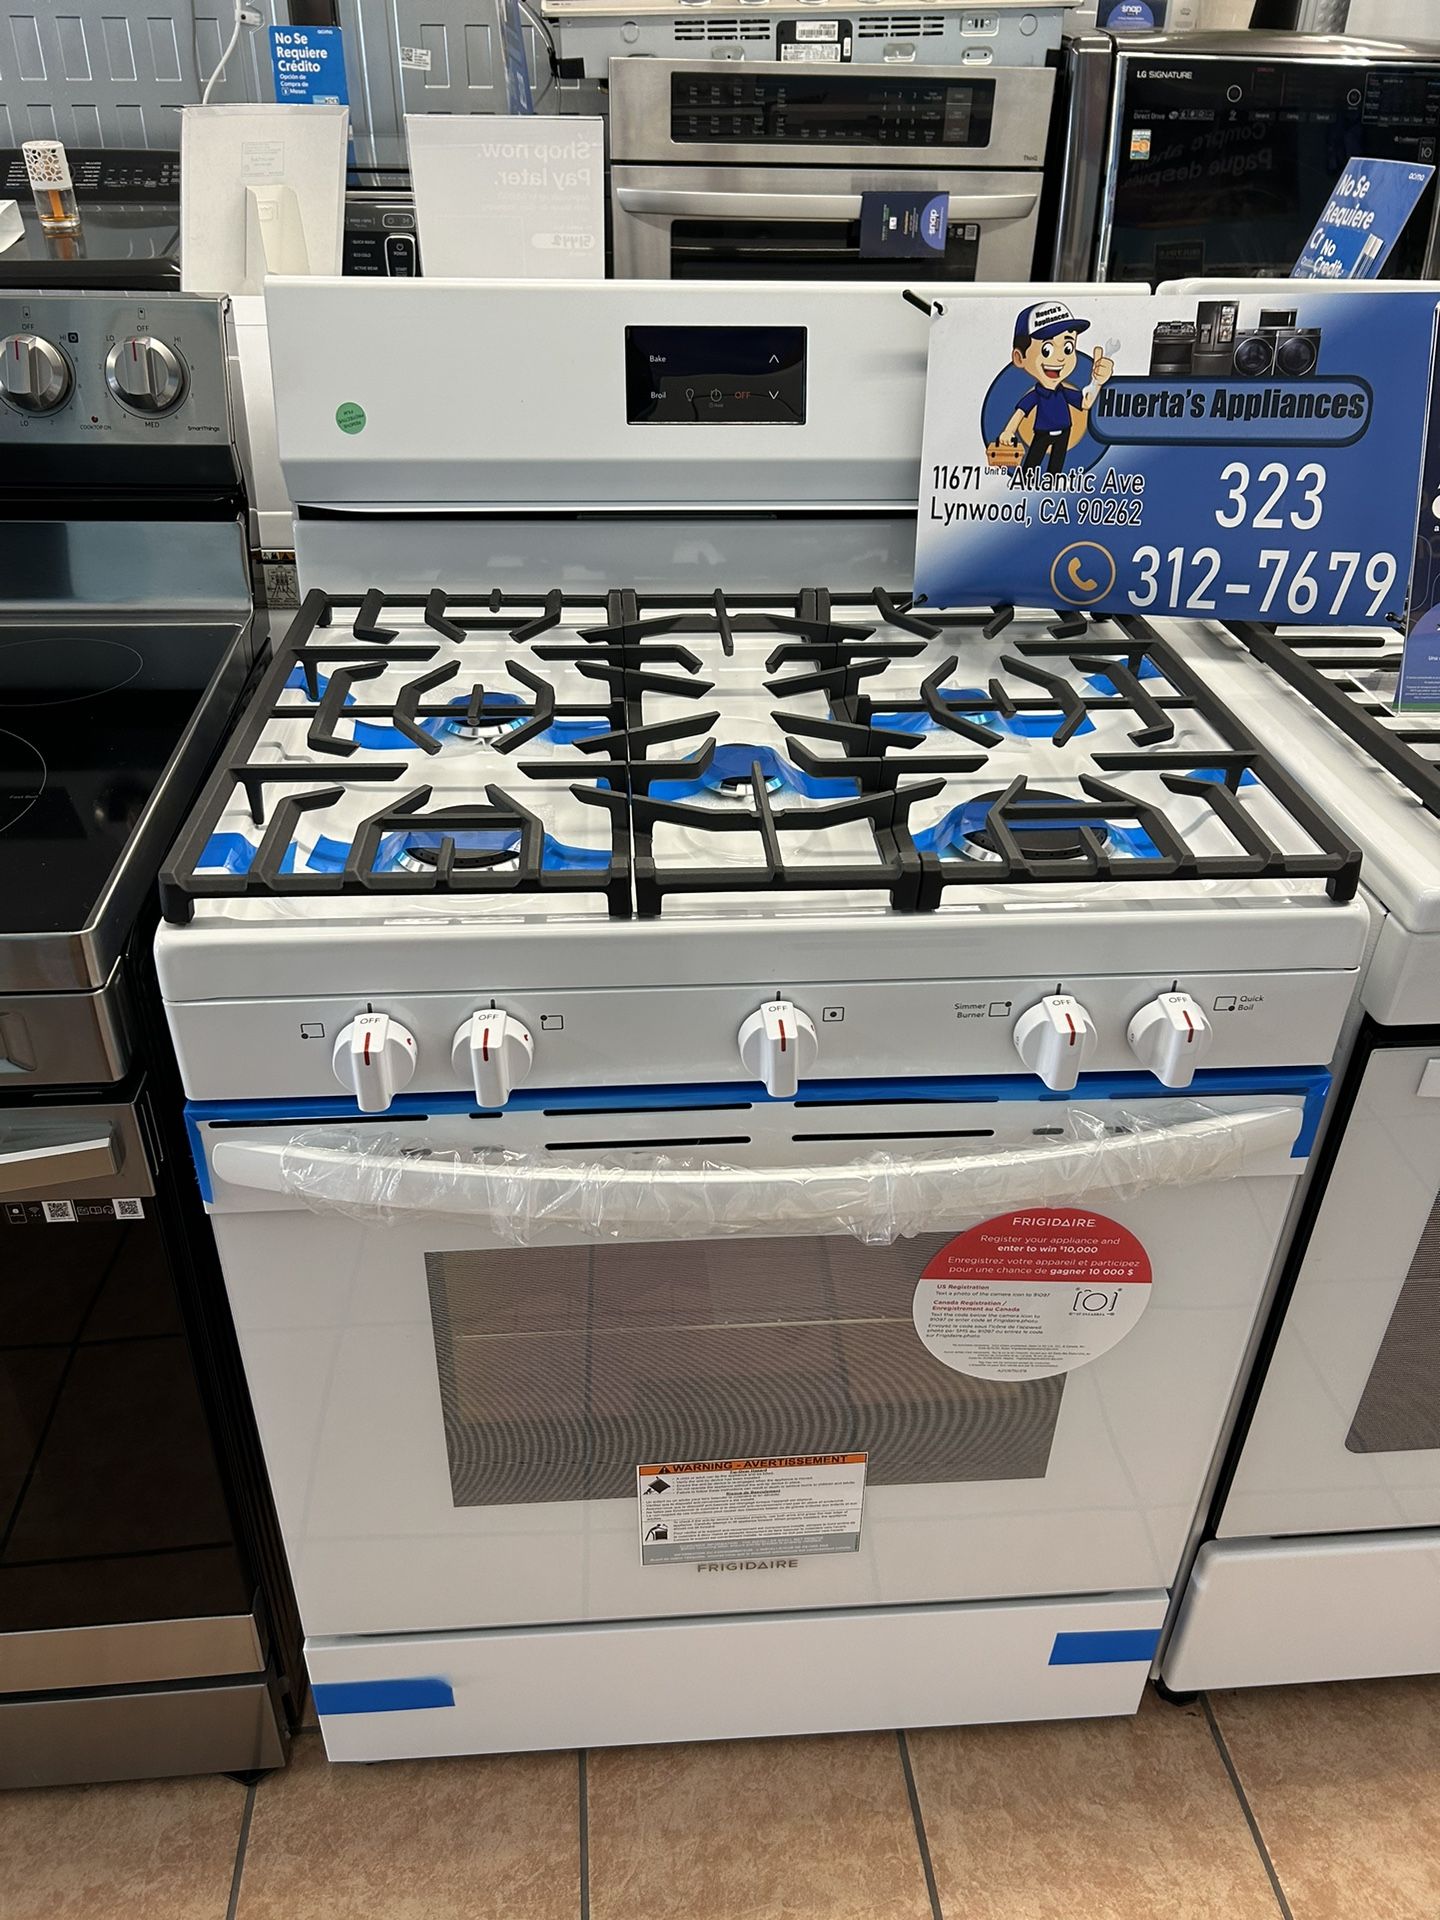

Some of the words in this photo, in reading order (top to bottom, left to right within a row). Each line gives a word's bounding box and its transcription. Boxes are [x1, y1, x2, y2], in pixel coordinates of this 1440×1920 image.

[1121, 5, 1142, 15] snap
[274, 32, 292, 44] No
[293, 32, 308, 44] Se
[276, 46, 328, 60] Requiere
[278, 60, 321, 72] Crédito
[1136, 70, 1147, 79] LG
[1149, 70, 1193, 80] SIGNATURE
[1336, 174, 1355, 196] No
[1352, 175, 1371, 198] Se
[928, 209, 939, 235] snap
[1322, 201, 1375, 230] Requiere
[1320, 238, 1337, 257] No
[1209, 389, 1365, 422] Appliances
[933, 465, 981, 490] 11671
[984, 467, 999, 476] Unit
[1000, 468, 1007, 476] B
[1008, 466, 1096, 493] Atlantic
[1101, 468, 1145, 495] Ave
[1214, 461, 1328, 531] 323
[930, 496, 1032, 528] Lynwood,
[1039, 498, 1070, 524] CA
[1077, 498, 1144, 526] 90262
[1127, 544, 1397, 618] 312-7679
[1052, 998, 1072, 1006] OFF
[1168, 996, 1188, 1004] OFF
[1240, 994, 1264, 1003] Quick
[954, 1002, 986, 1010] Simmer
[957, 1010, 985, 1019] Burner
[1012, 1218, 1096, 1228] FRIGIDAIRE
[980, 1235, 1022, 1244] Register
[1024, 1237, 1048, 1246] your
[1050, 1237, 1099, 1246] appliance
[948, 1256, 1003, 1266] Enregistrez
[1006, 1258, 1033, 1266] votre
[1036, 1258, 1076, 1268] appareil
[1092, 1259, 1140, 1269] participez
[996, 1266, 1032, 1274] chance
[1050, 1268, 1086, 1276] gagner
[1089, 1268, 1100, 1276] 10
[1127, 1268, 1134, 1276] $
[672, 1462, 732, 1472] WARNING
[744, 1455, 848, 1468] AVERTISSEMENT
[697, 1559, 799, 1573] FRIGIDAIRE
